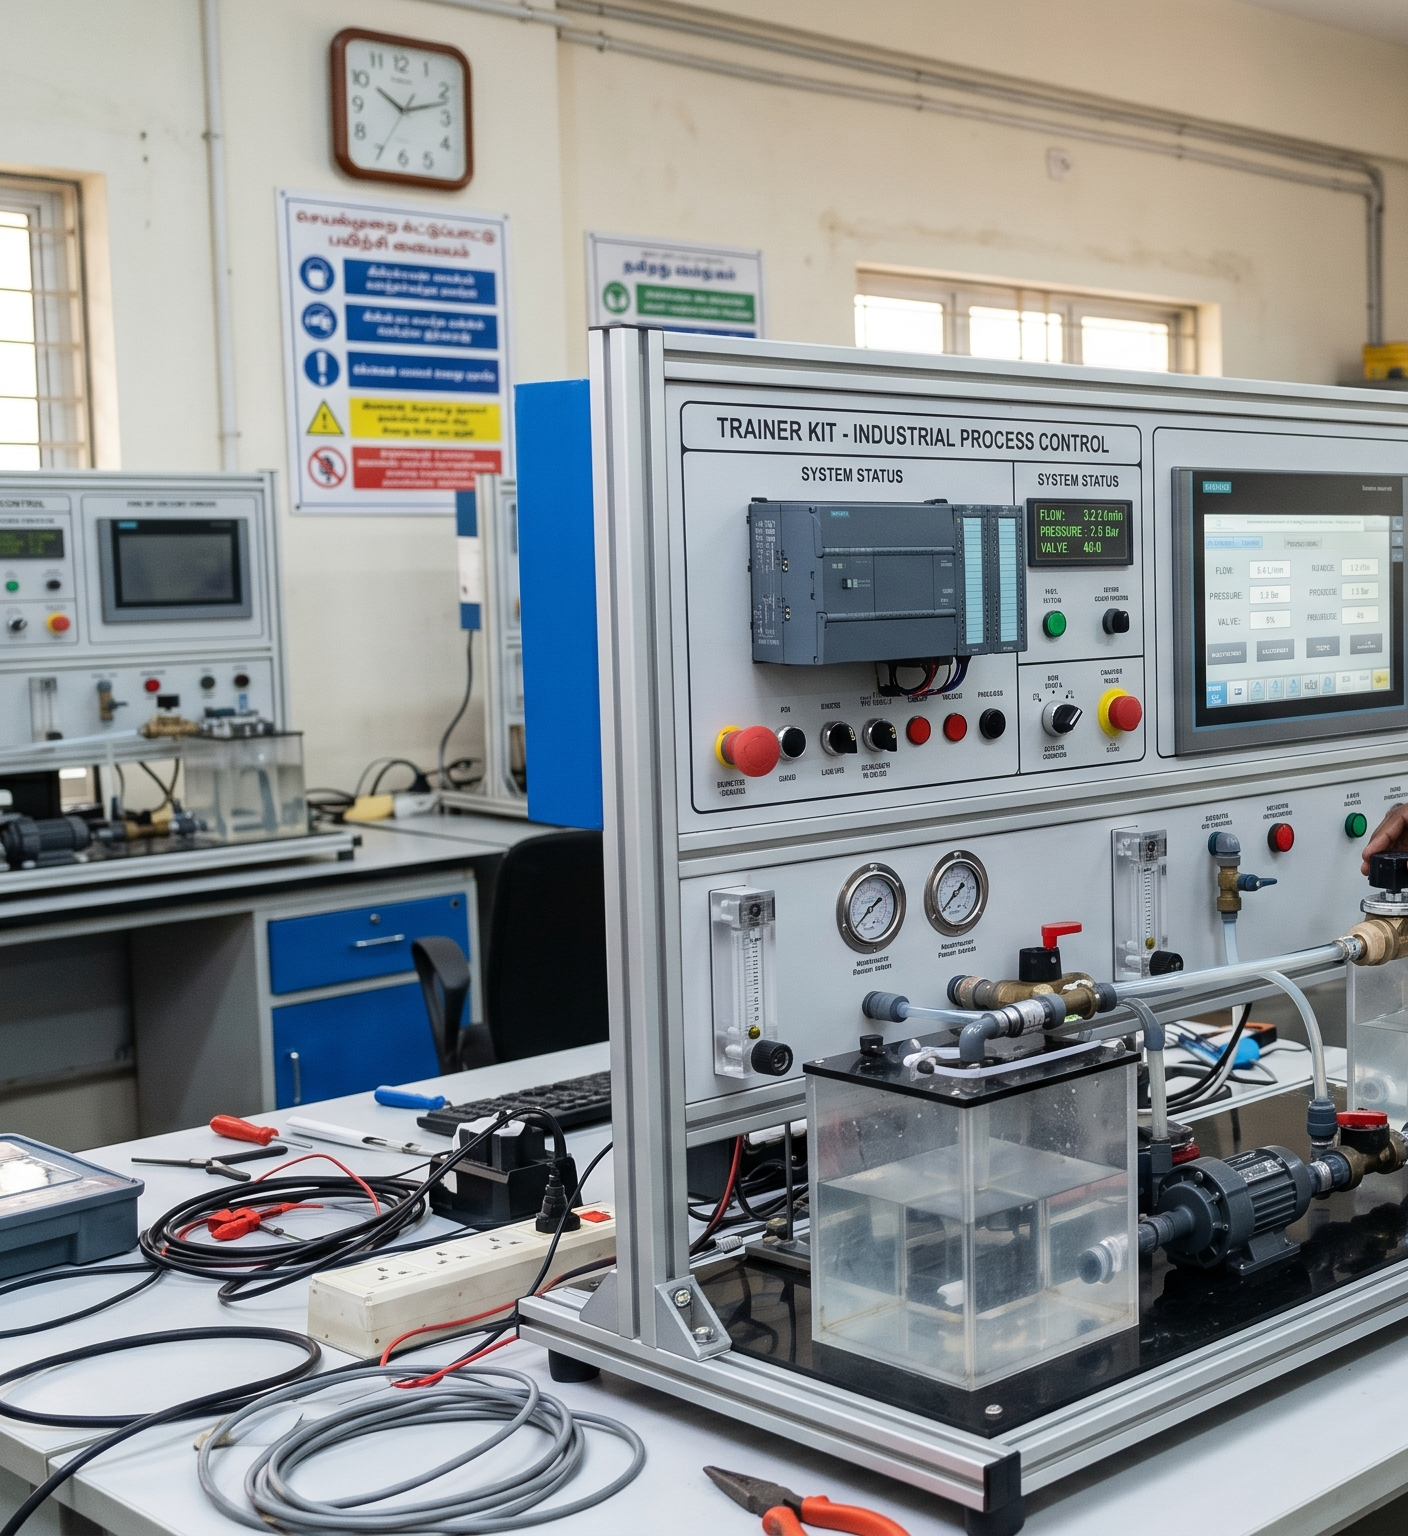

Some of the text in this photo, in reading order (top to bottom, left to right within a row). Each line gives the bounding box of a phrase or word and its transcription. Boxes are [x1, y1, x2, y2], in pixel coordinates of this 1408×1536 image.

[370, 50, 383, 70] 11
[394, 54, 410, 74] 12
[352, 68, 370, 89] 10
[439, 81, 450, 101] 2
[352, 94, 364, 114] 9
[441, 108, 451, 128] 3
[355, 121, 367, 141] 8
[398, 148, 409, 168] 6
[423, 150, 434, 170] 5
[716, 416, 803, 441] TRAINER
[808, 421, 837, 442] KIT
[853, 423, 955, 447] INDUSTRIAL
[960, 428, 1034, 450] PROCESS
[1039, 432, 1109, 453] CONTROL
[801, 466, 903, 484] SYSTEM STATUS
[1038, 473, 1119, 487] SYSTEM STATUS
[1040, 509, 1065, 521] FLOW:
[1105, 525, 1119, 537] Bar
